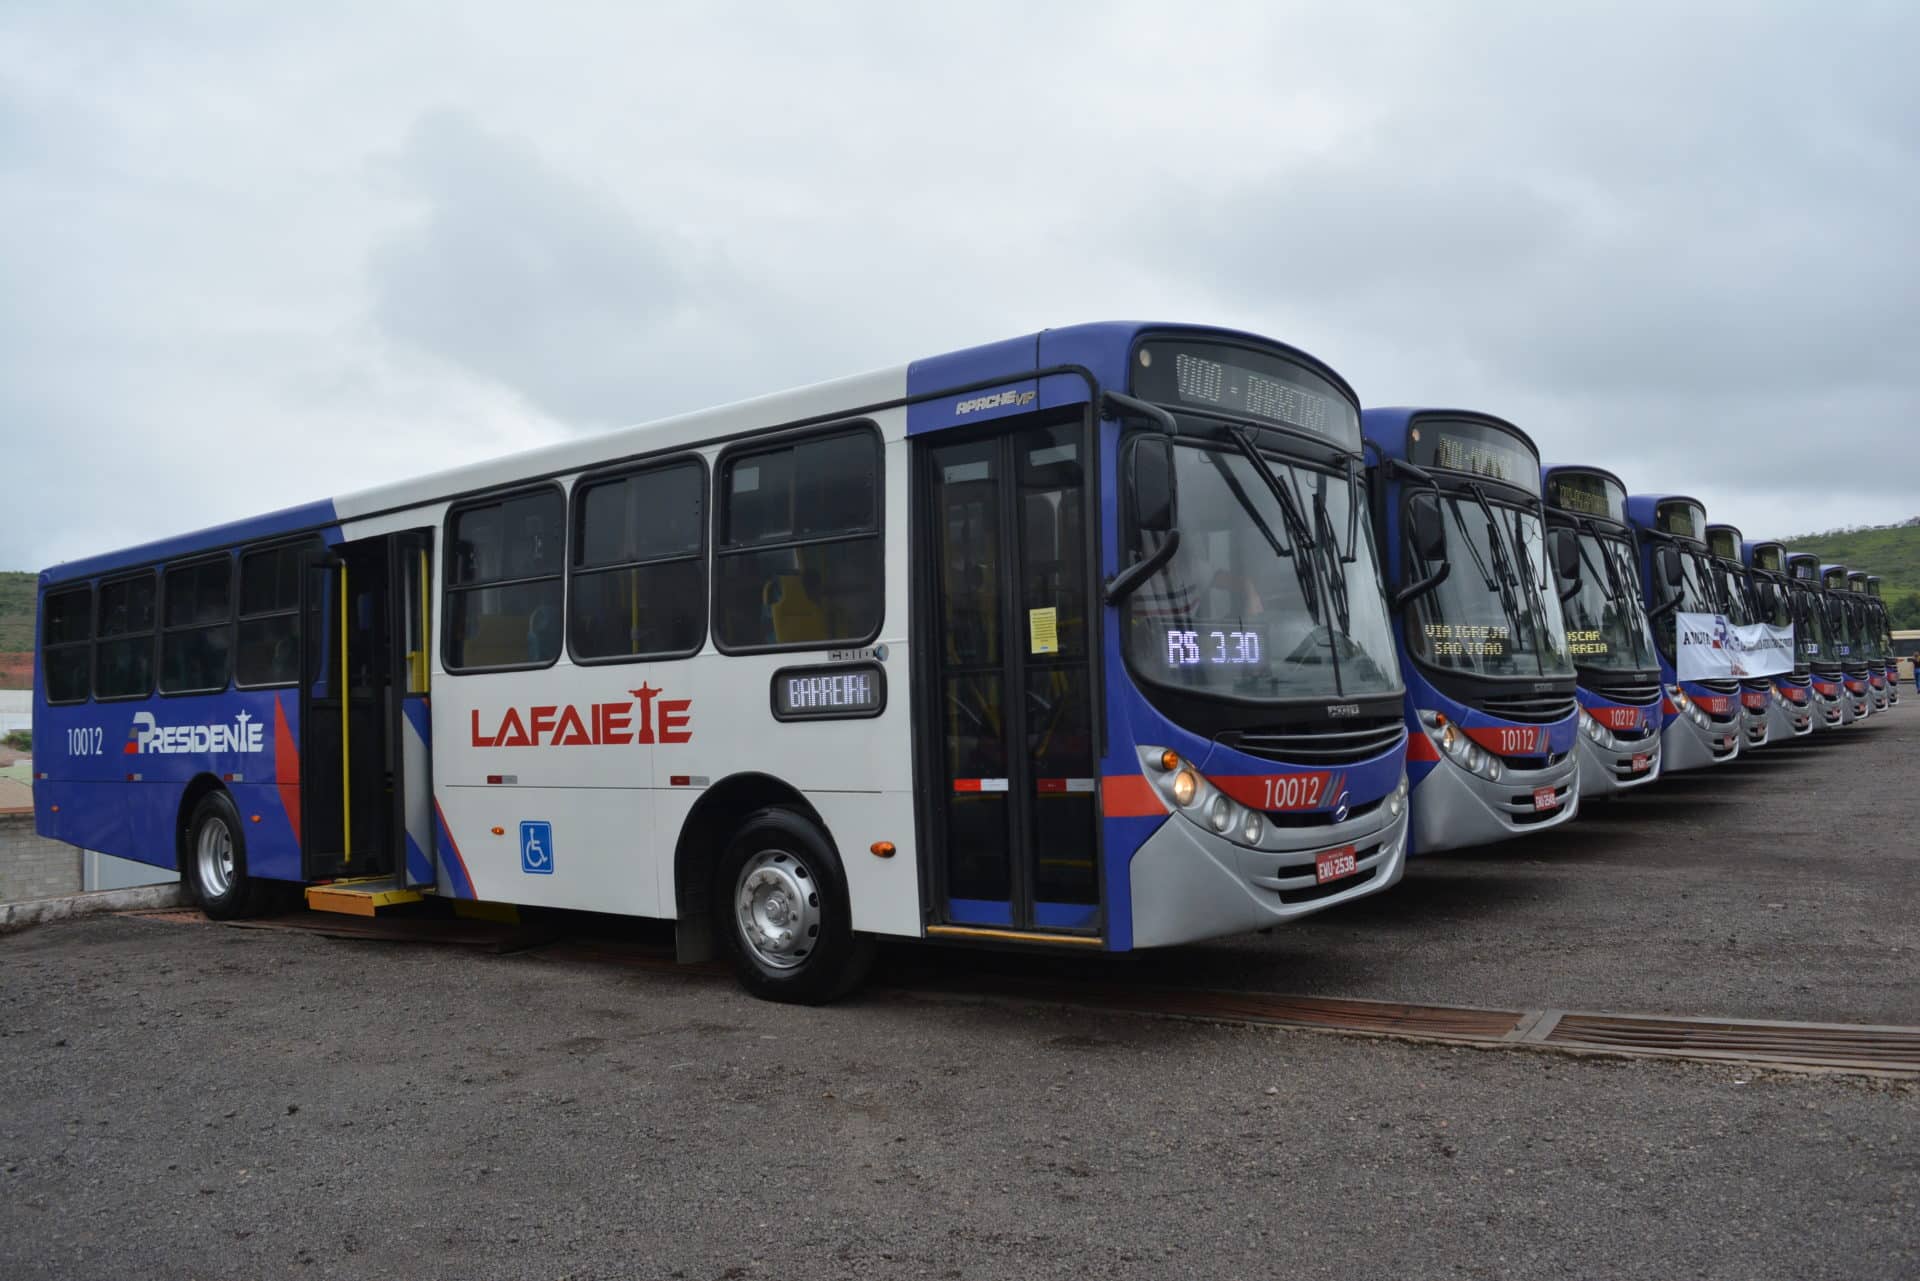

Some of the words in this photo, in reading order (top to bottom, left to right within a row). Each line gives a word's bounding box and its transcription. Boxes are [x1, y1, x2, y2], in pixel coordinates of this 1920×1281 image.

[956, 390, 1016, 415] APACHE
[1425, 625, 1451, 637] VIA
[1455, 625, 1508, 639] IGREJA
[1168, 631, 1200, 664] R$
[789, 675, 870, 707] BARREIRA
[472, 681, 693, 747] LAFAIETE
[1611, 710, 1634, 726] 10212
[67, 727, 103, 756] 10012
[1501, 729, 1534, 750] 10112
[1265, 776, 1319, 808] 10012
